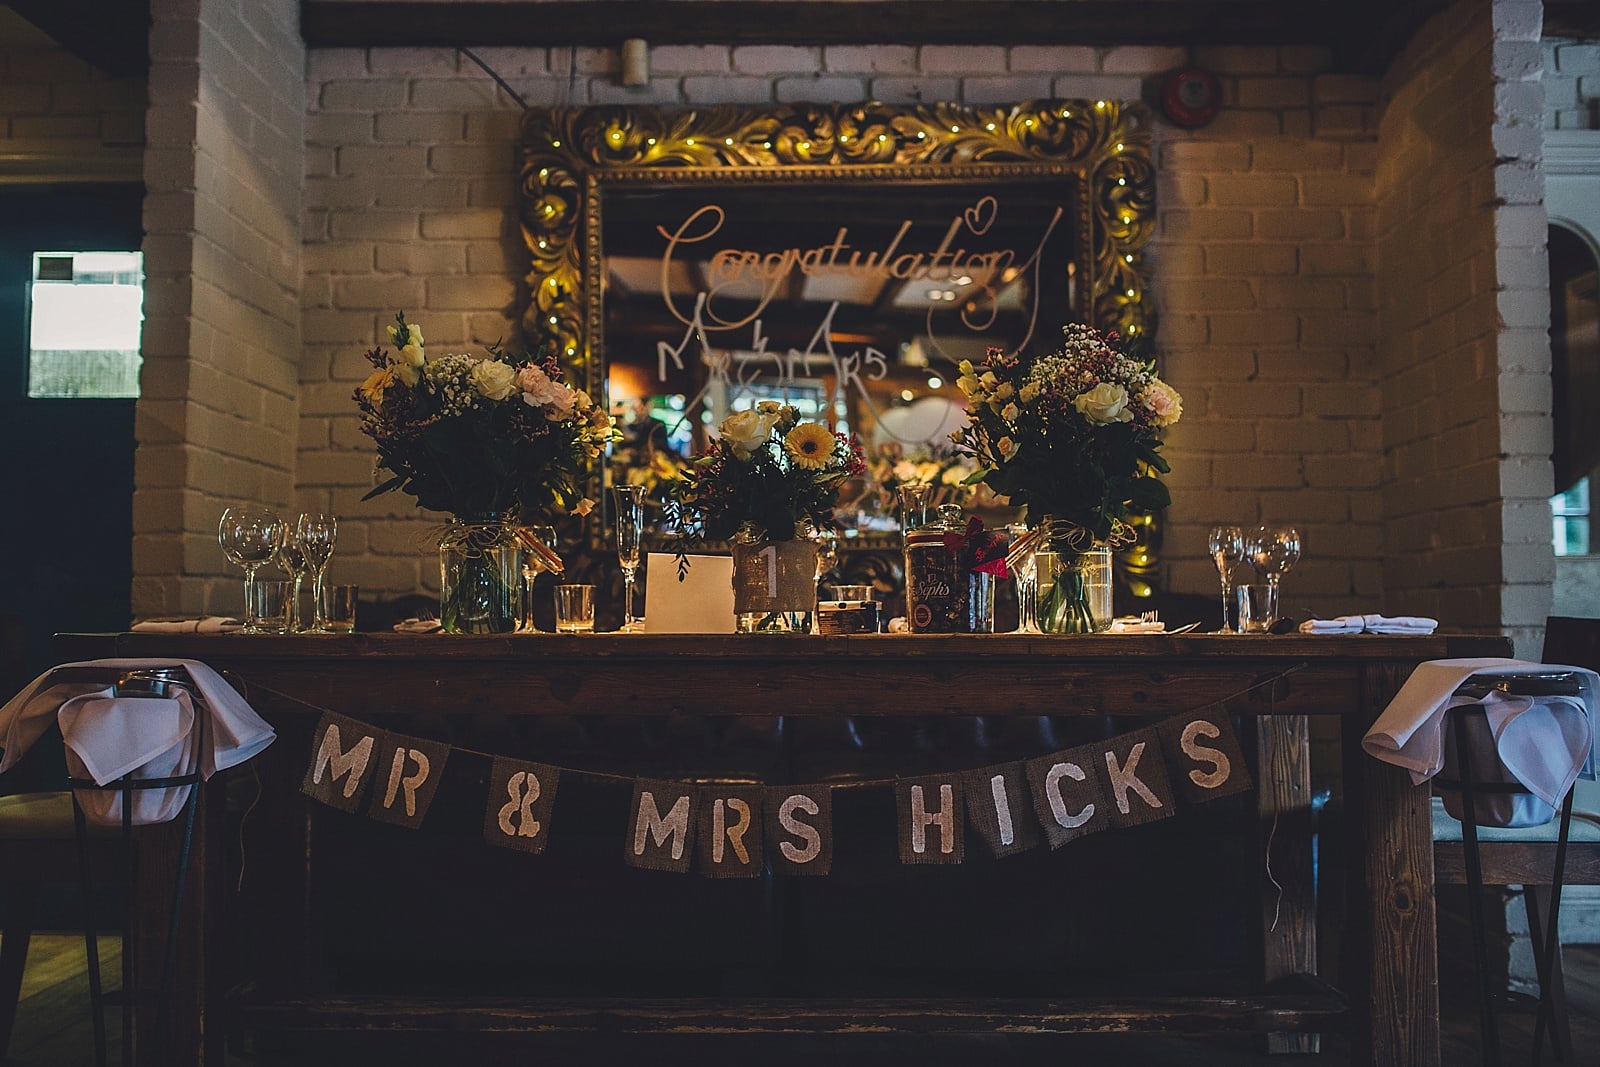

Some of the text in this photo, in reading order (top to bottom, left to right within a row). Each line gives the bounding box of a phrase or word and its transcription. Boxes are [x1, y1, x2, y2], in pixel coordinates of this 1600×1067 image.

[757, 545, 777, 599] 1
[313, 719, 1231, 864] MR & MRS HICKS
